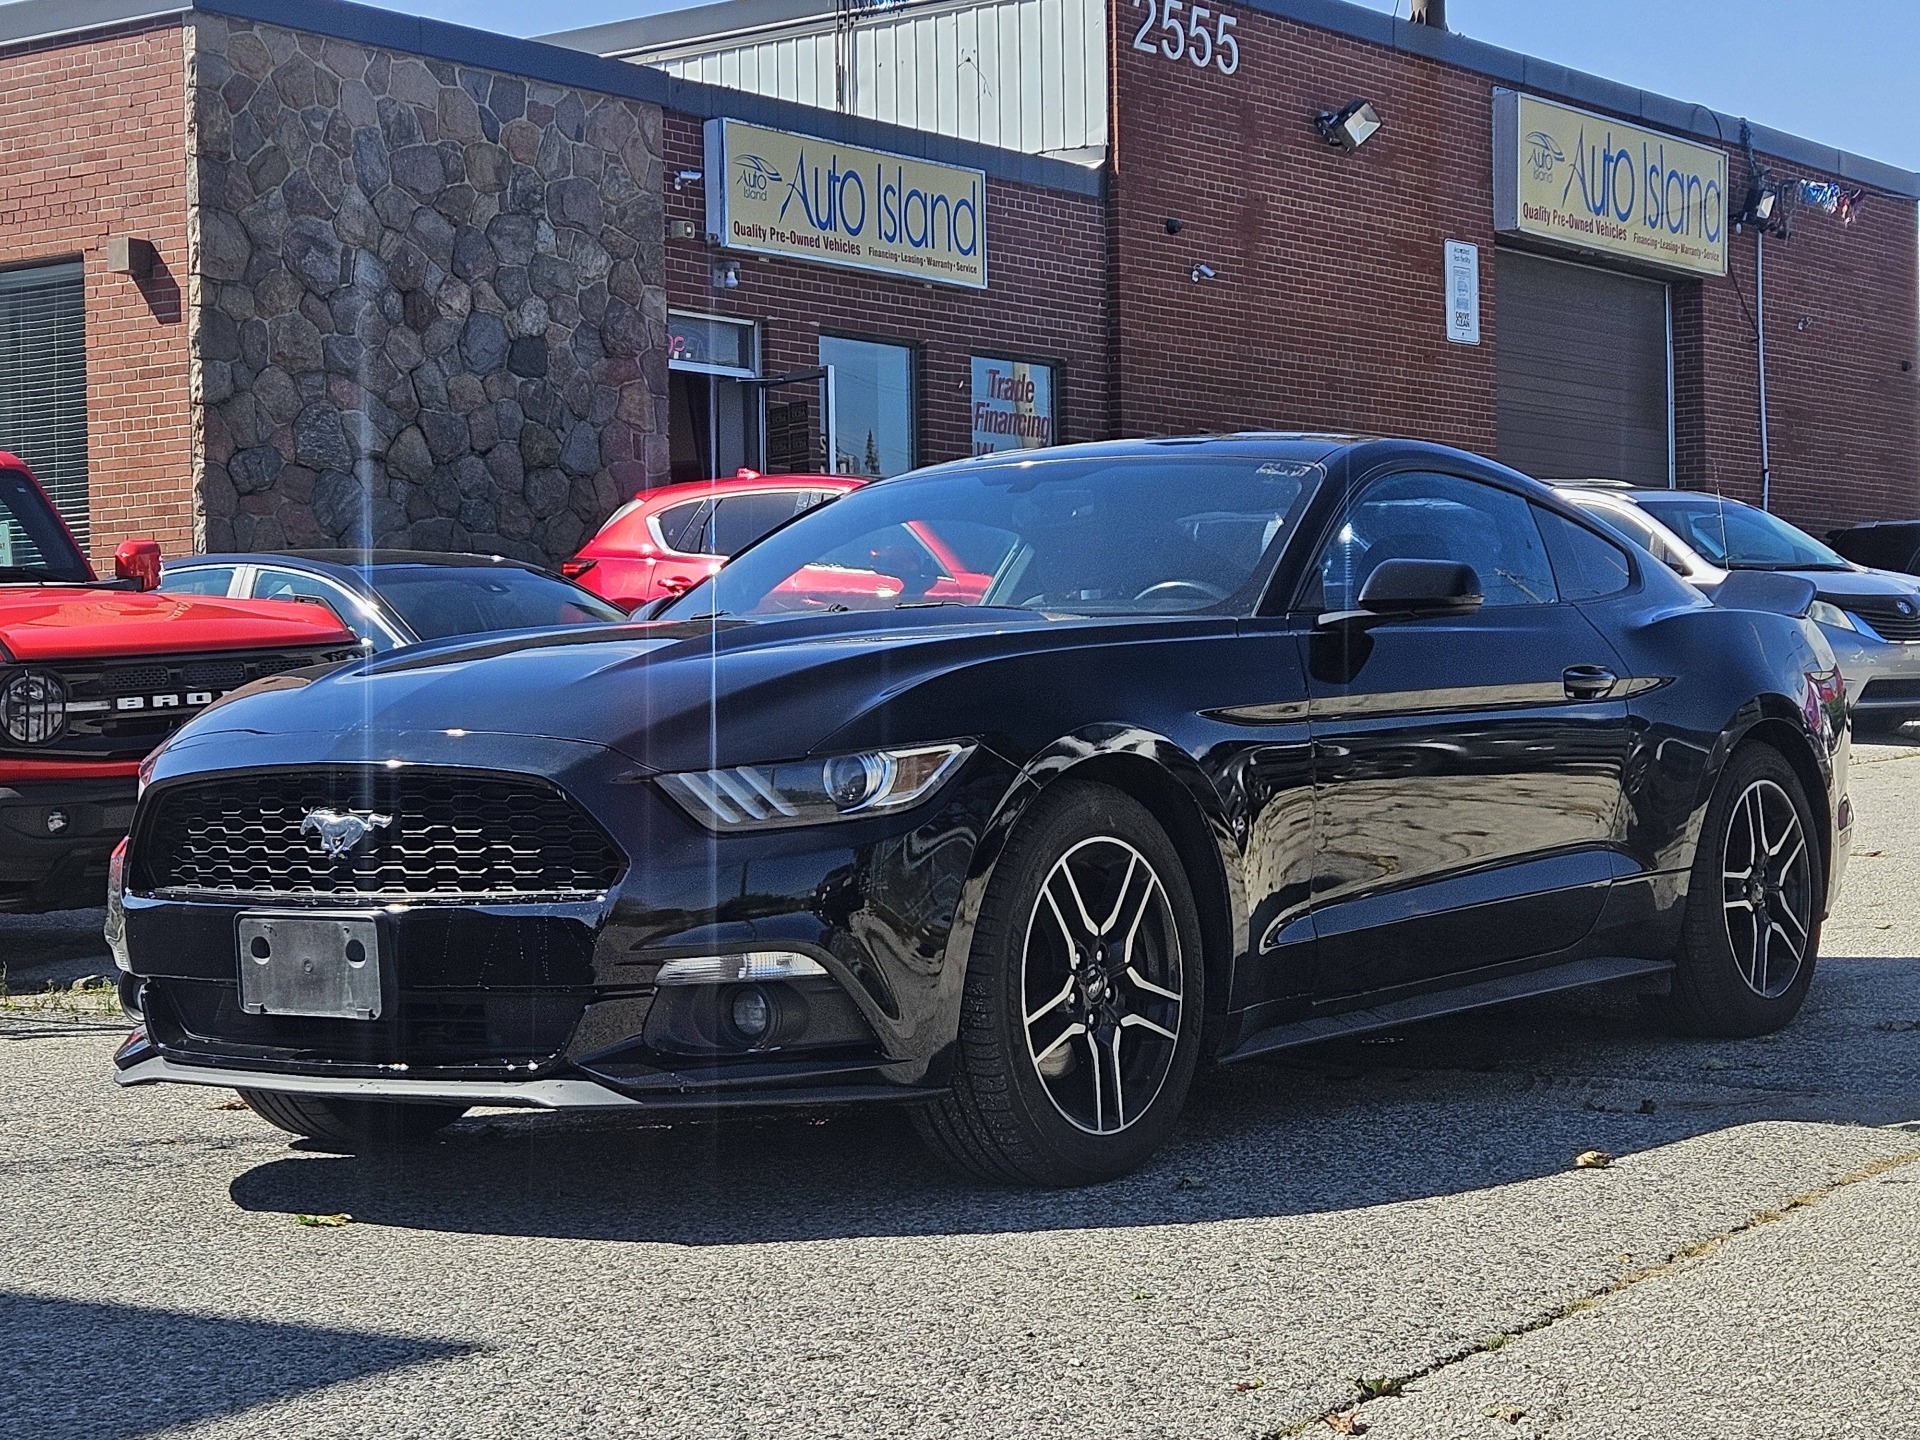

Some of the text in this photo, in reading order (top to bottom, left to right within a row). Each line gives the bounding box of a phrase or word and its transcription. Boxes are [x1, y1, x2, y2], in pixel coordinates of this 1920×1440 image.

[1132, 0, 1239, 75] 2555
[1527, 148, 1553, 171] Auto
[736, 169, 767, 191] Auto
[743, 187, 767, 201] Island
[1562, 123, 1721, 243] Auto Island
[779, 146, 977, 256] Auto Island
[733, 220, 861, 256] Quality Pre-Owned Vehicles
[1523, 202, 1627, 241] Quality Pre-Owned Vehicles
[988, 368, 1035, 404] Trade
[974, 401, 1051, 446] Financing
[117, 691, 231, 710] BRO
